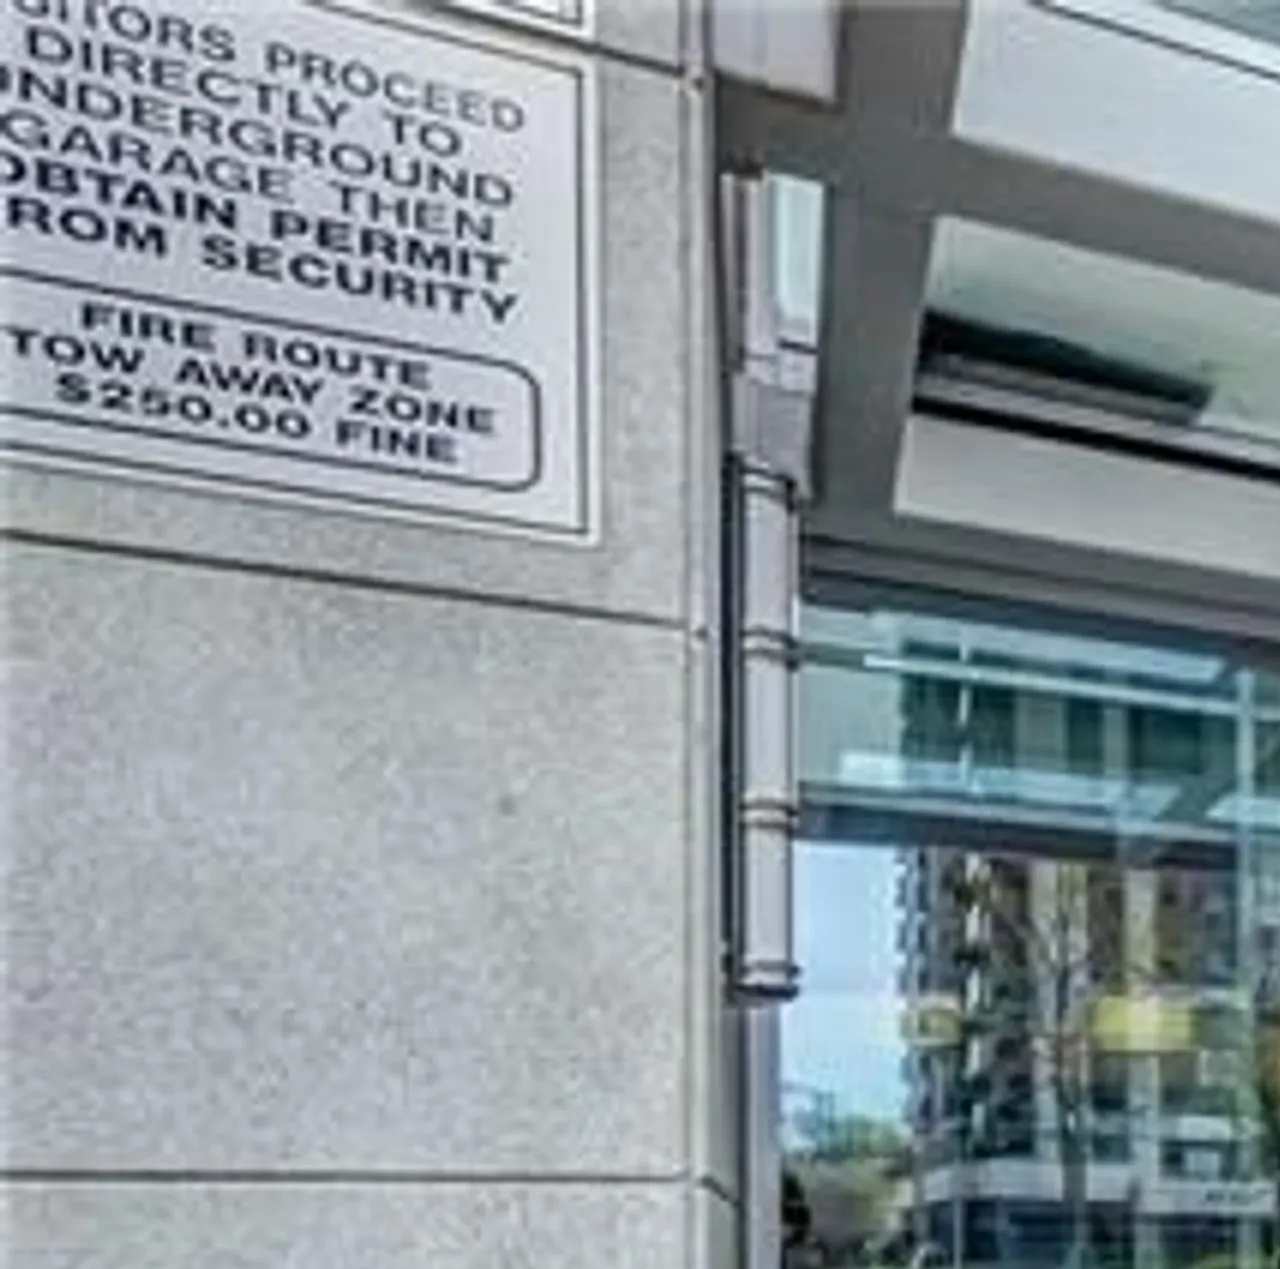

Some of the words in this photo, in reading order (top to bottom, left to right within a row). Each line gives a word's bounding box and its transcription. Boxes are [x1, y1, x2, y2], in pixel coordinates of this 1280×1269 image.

[27, 26, 350, 130] DIRECTLY
[382, 106, 463, 157] TO
[265, 42, 525, 132] PROCEED
[0, 109, 296, 205] GARAGE
[327, 180, 494, 243] THEN
[7, 196, 167, 260] ROM
[202, 235, 518, 324] SECURITY
[270, 210, 510, 282] PERMIT
[6, 326, 145, 374] TOW
[174, 357, 325, 405] AWAY
[351, 385, 494, 434] ZONE
[81, 302, 215, 353] FIRE
[243, 332, 430, 391] ROUTE
[56, 372, 311, 440] $250.00
[337, 417, 458, 464] FINE
